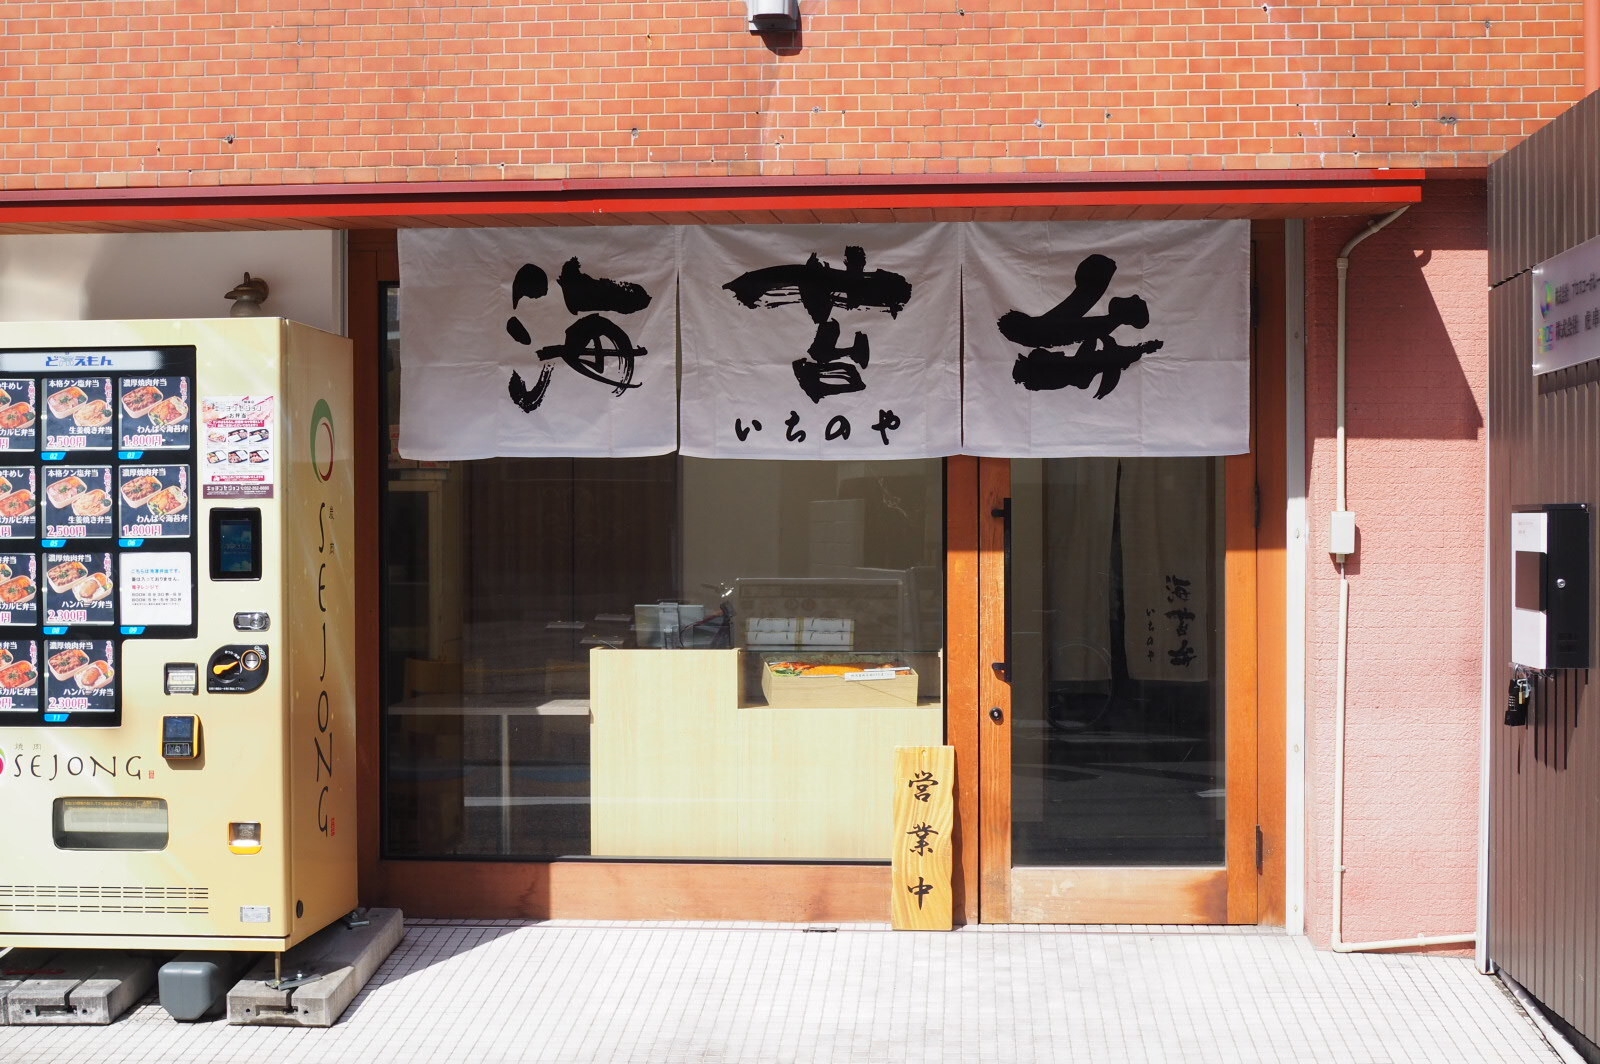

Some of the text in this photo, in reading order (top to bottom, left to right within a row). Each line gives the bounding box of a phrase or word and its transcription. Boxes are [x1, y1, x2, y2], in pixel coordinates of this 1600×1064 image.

[0, 382, 23, 390] 牛めし
[48, 380, 100, 388] 本格タン塩弁当
[123, 379, 167, 387] 濃厚焼肉弁当
[735, 409, 901, 446] いちのや
[48, 469, 99, 478] 本格タン塩弁当
[122, 468, 166, 477] 濃厚焼肉弁当
[0, 516, 36, 524] カルビ弁当
[0, 602, 37, 610] カルビ弁当
[61, 601, 113, 609] ハンバーグ弁当
[1146, 608, 1156, 662] いちのや
[49, 641, 94, 650] 濃厚焼肉弁当
[63, 688, 114, 696] ハンバーグ弁当
[14, 753, 142, 781] SEJONG
[906, 769, 939, 911] 営業中
